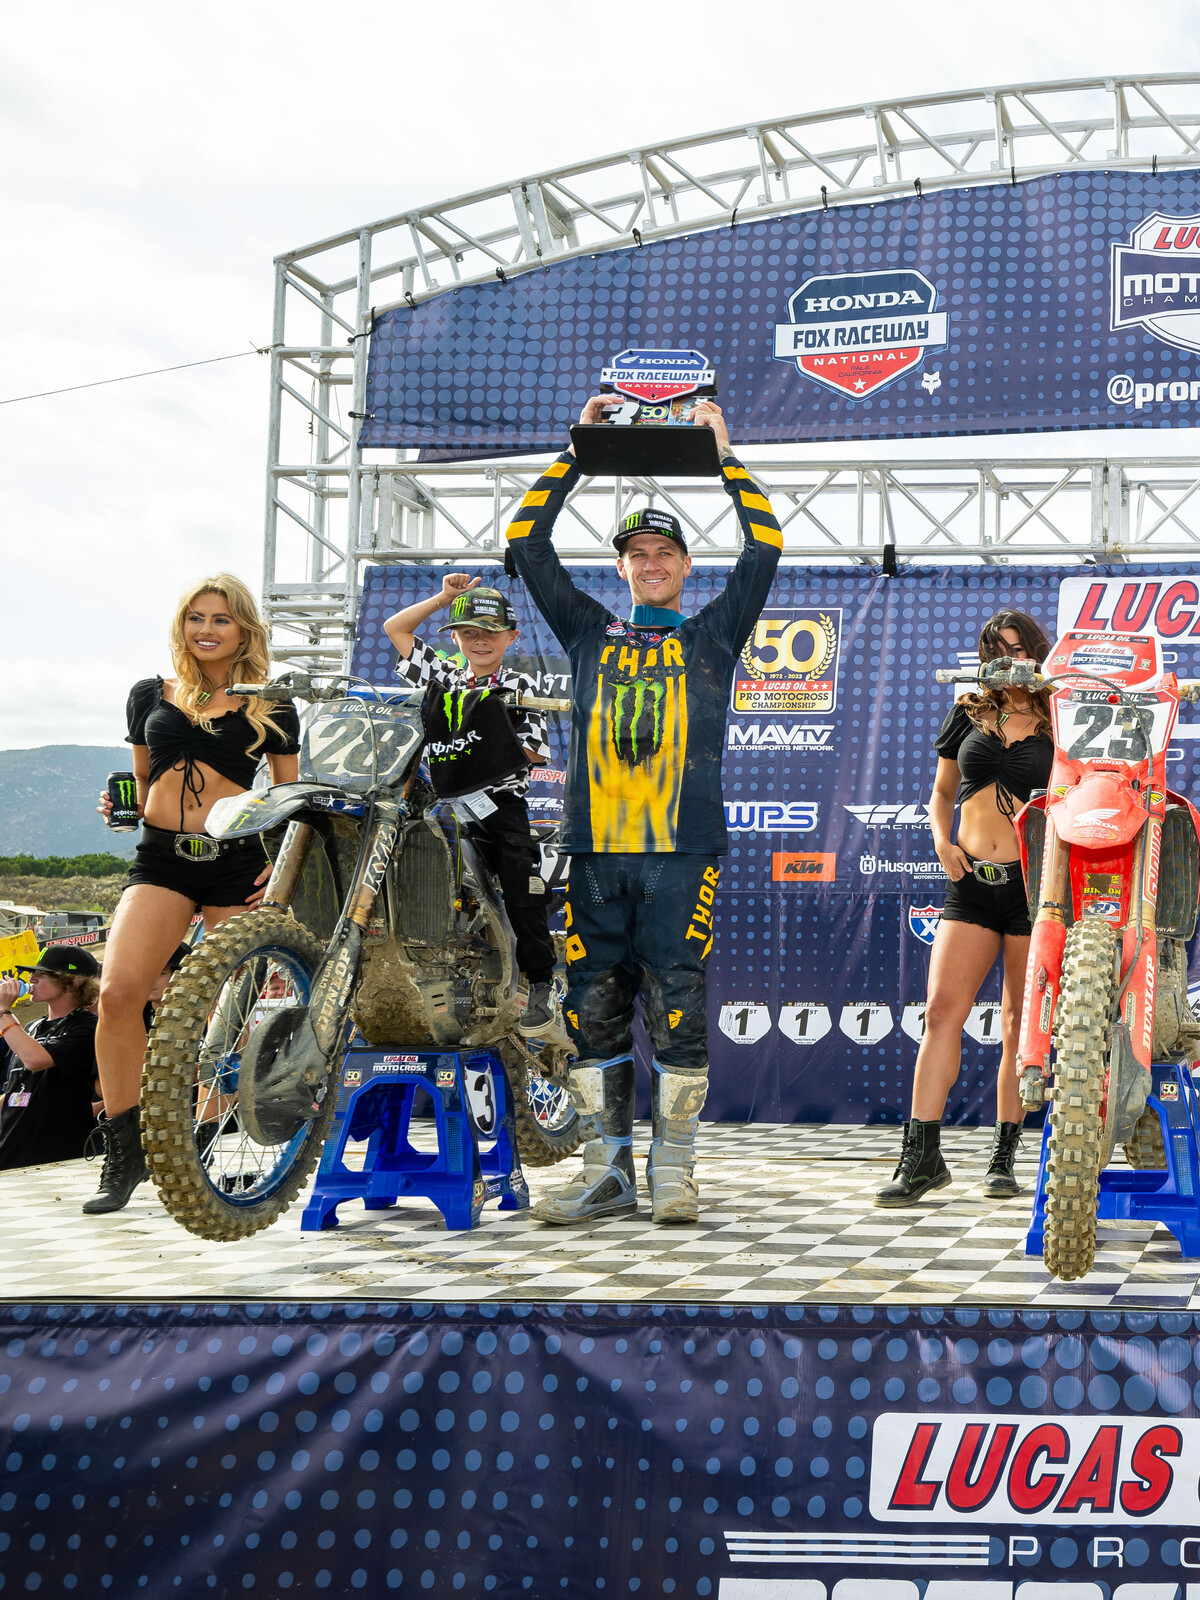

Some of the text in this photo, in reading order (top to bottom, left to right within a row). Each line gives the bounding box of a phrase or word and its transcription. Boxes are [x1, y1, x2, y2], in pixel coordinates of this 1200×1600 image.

[804, 290, 925, 313] HONDA
[793, 320, 929, 350] FOX RACEWAY
[638, 358, 700, 366] HONDA
[813, 351, 908, 366] NATIONAL
[609, 371, 634, 380] FOX
[636, 371, 700, 381] RACEWAY
[837, 370, 883, 378] CALIFORNIA
[640, 406, 668, 419] 50
[750, 619, 828, 673] 50
[1072, 656, 1132, 665] MOTOCROSS
[763, 682, 808, 690] LUCAS OIL
[739, 692, 829, 701] PRO MOTOCROSS
[376, 706, 393, 715] OIL
[728, 725, 835, 745] MAVTV
[1068, 706, 1154, 761] 23
[724, 805, 816, 829] WPS
[784, 859, 823, 874] KTM
[1084, 887, 1121, 895] HINON
[685, 866, 720, 942] THOR
[1143, 955, 1156, 1052] DUNLOP
[346, 1071, 361, 1081] 50
[438, 1071, 453, 1081] 50
[1162, 1083, 1177, 1094] 50
[474, 1075, 492, 1132] 3
[888, 1421, 1181, 1517] LUCAS
